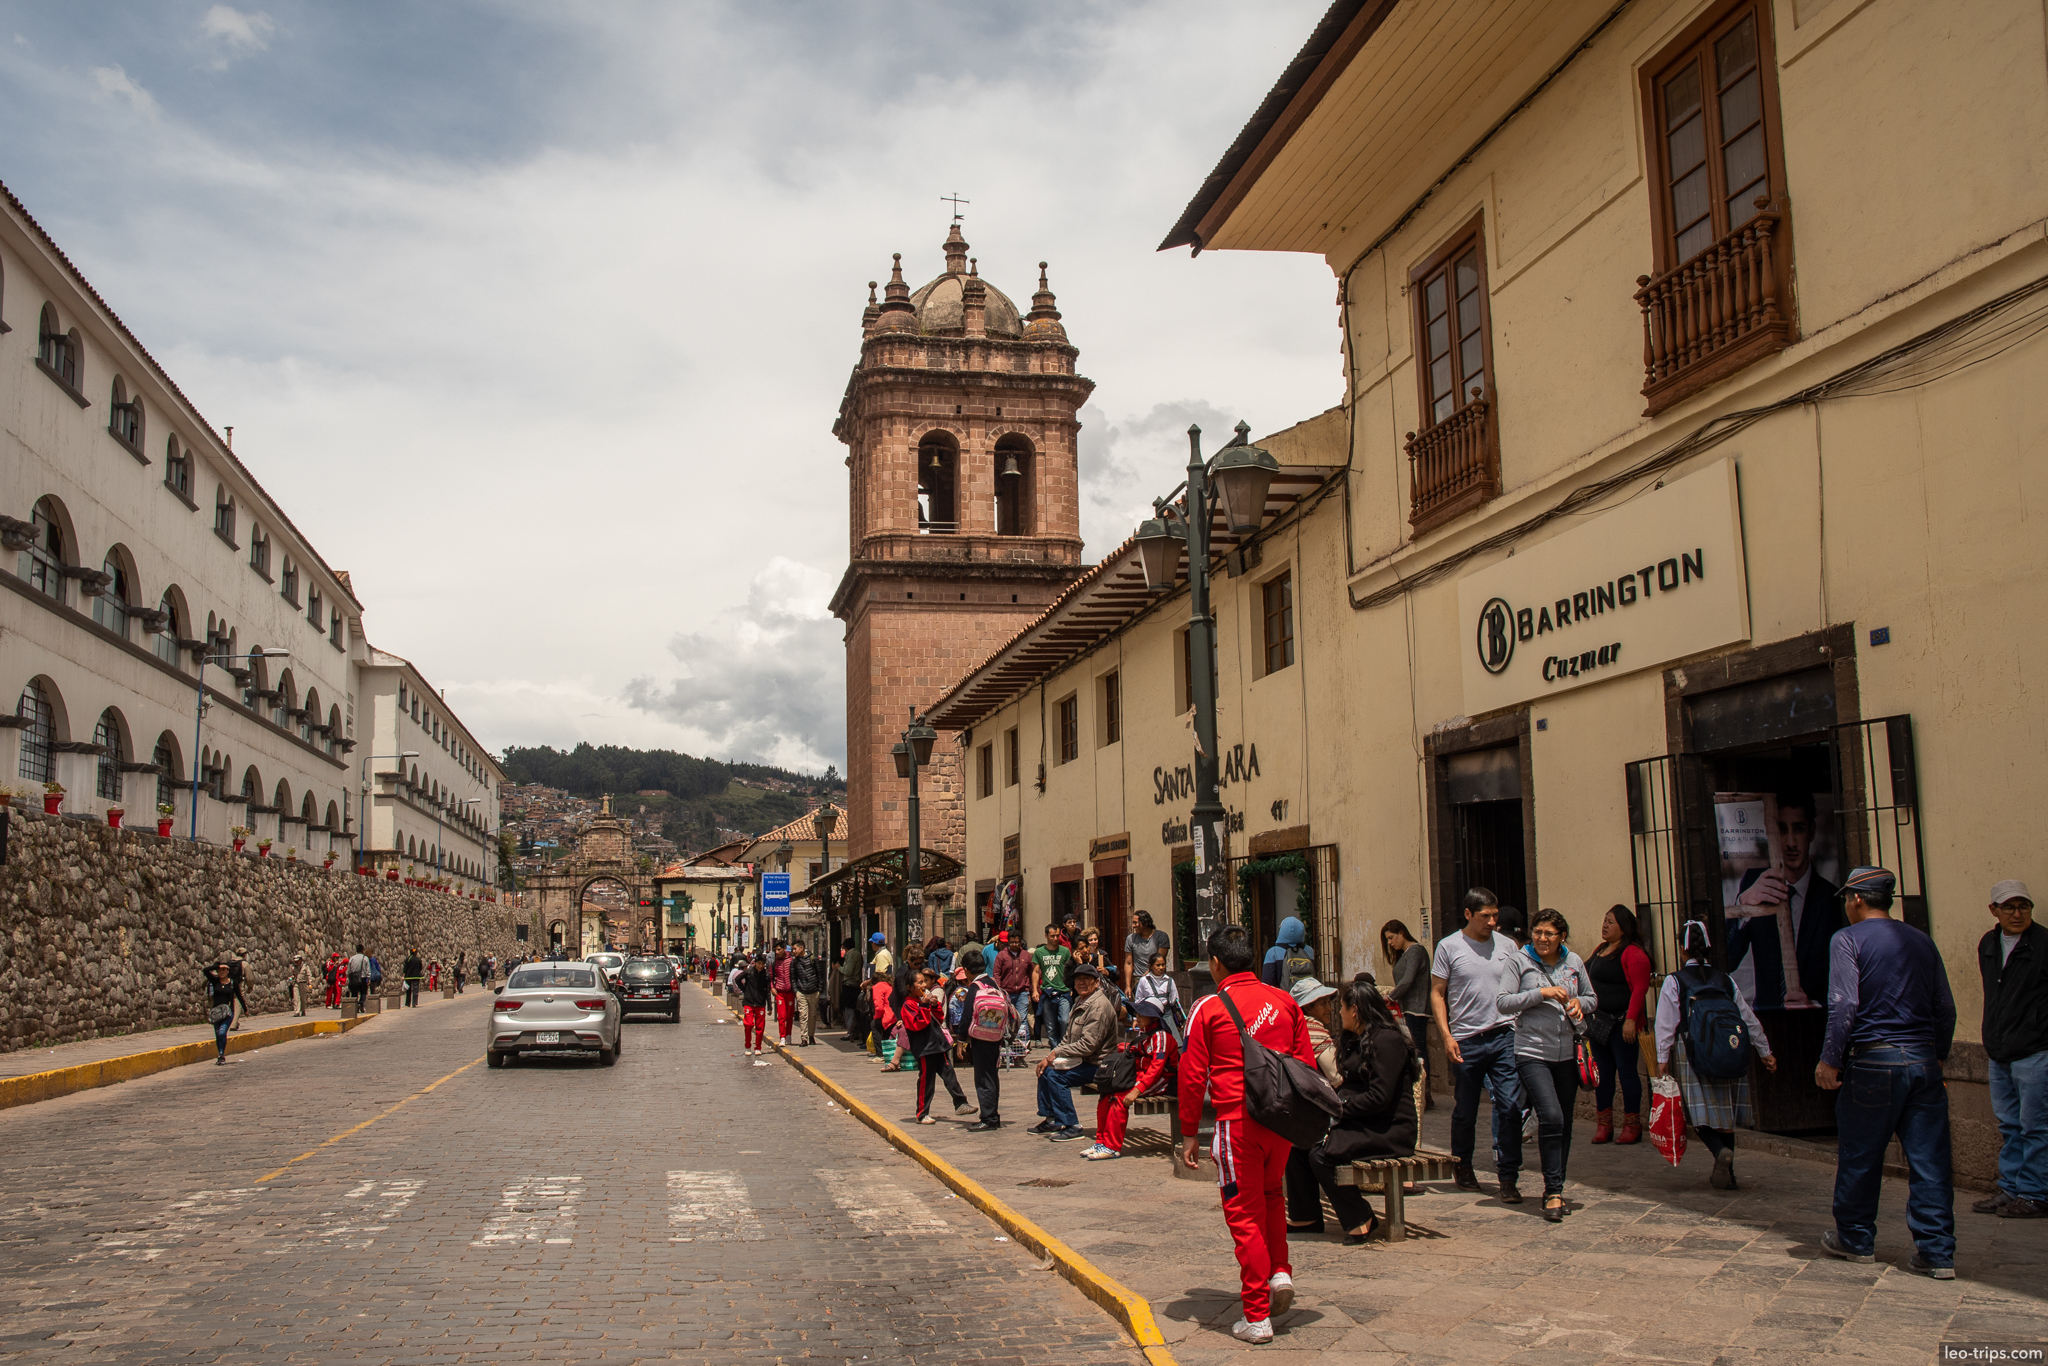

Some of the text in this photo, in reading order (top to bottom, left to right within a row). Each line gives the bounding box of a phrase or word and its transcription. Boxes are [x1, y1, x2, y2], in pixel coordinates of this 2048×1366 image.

[1516, 547, 1704, 642] BARRINGTON
[1541, 642, 1622, 682] Cuzmar
[1153, 742, 1261, 805] SANTA ARA
[1246, 1001, 1273, 1037] iencias
